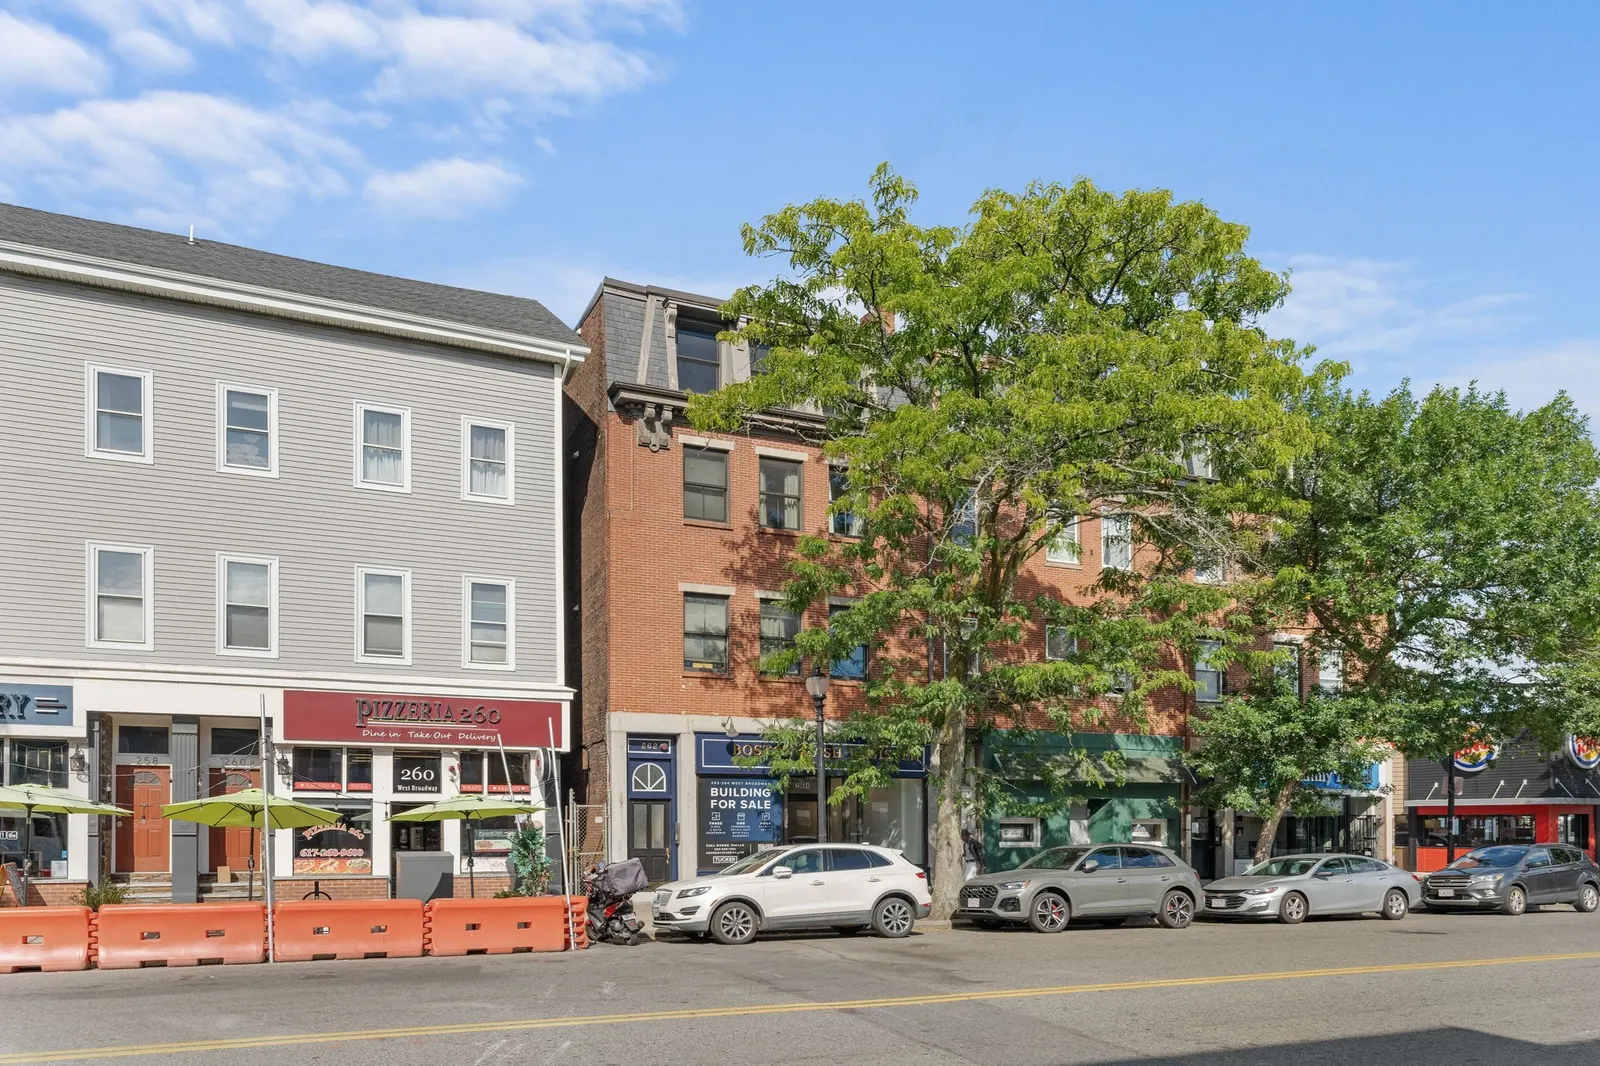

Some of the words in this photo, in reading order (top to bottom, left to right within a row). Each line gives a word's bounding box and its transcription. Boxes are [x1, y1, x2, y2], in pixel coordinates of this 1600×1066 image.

[355, 698, 456, 728] PIZZERIA
[459, 703, 501, 725] 260
[362, 729, 387, 738] Dine
[388, 730, 402, 738] in
[408, 730, 432, 739] Take
[433, 731, 453, 739] Out
[458, 732, 497, 742] Delivery
[641, 742, 658, 750] 262
[136, 756, 159, 765] 258
[224, 756, 247, 766] 260
[401, 766, 434, 781] 260
[397, 784, 411, 792] West
[411, 784, 438, 792] Broadway
[710, 787, 771, 797] BUILDING
[710, 799, 736, 809] FOR
[740, 799, 771, 809] SALE
[347, 827, 365, 840] 260
